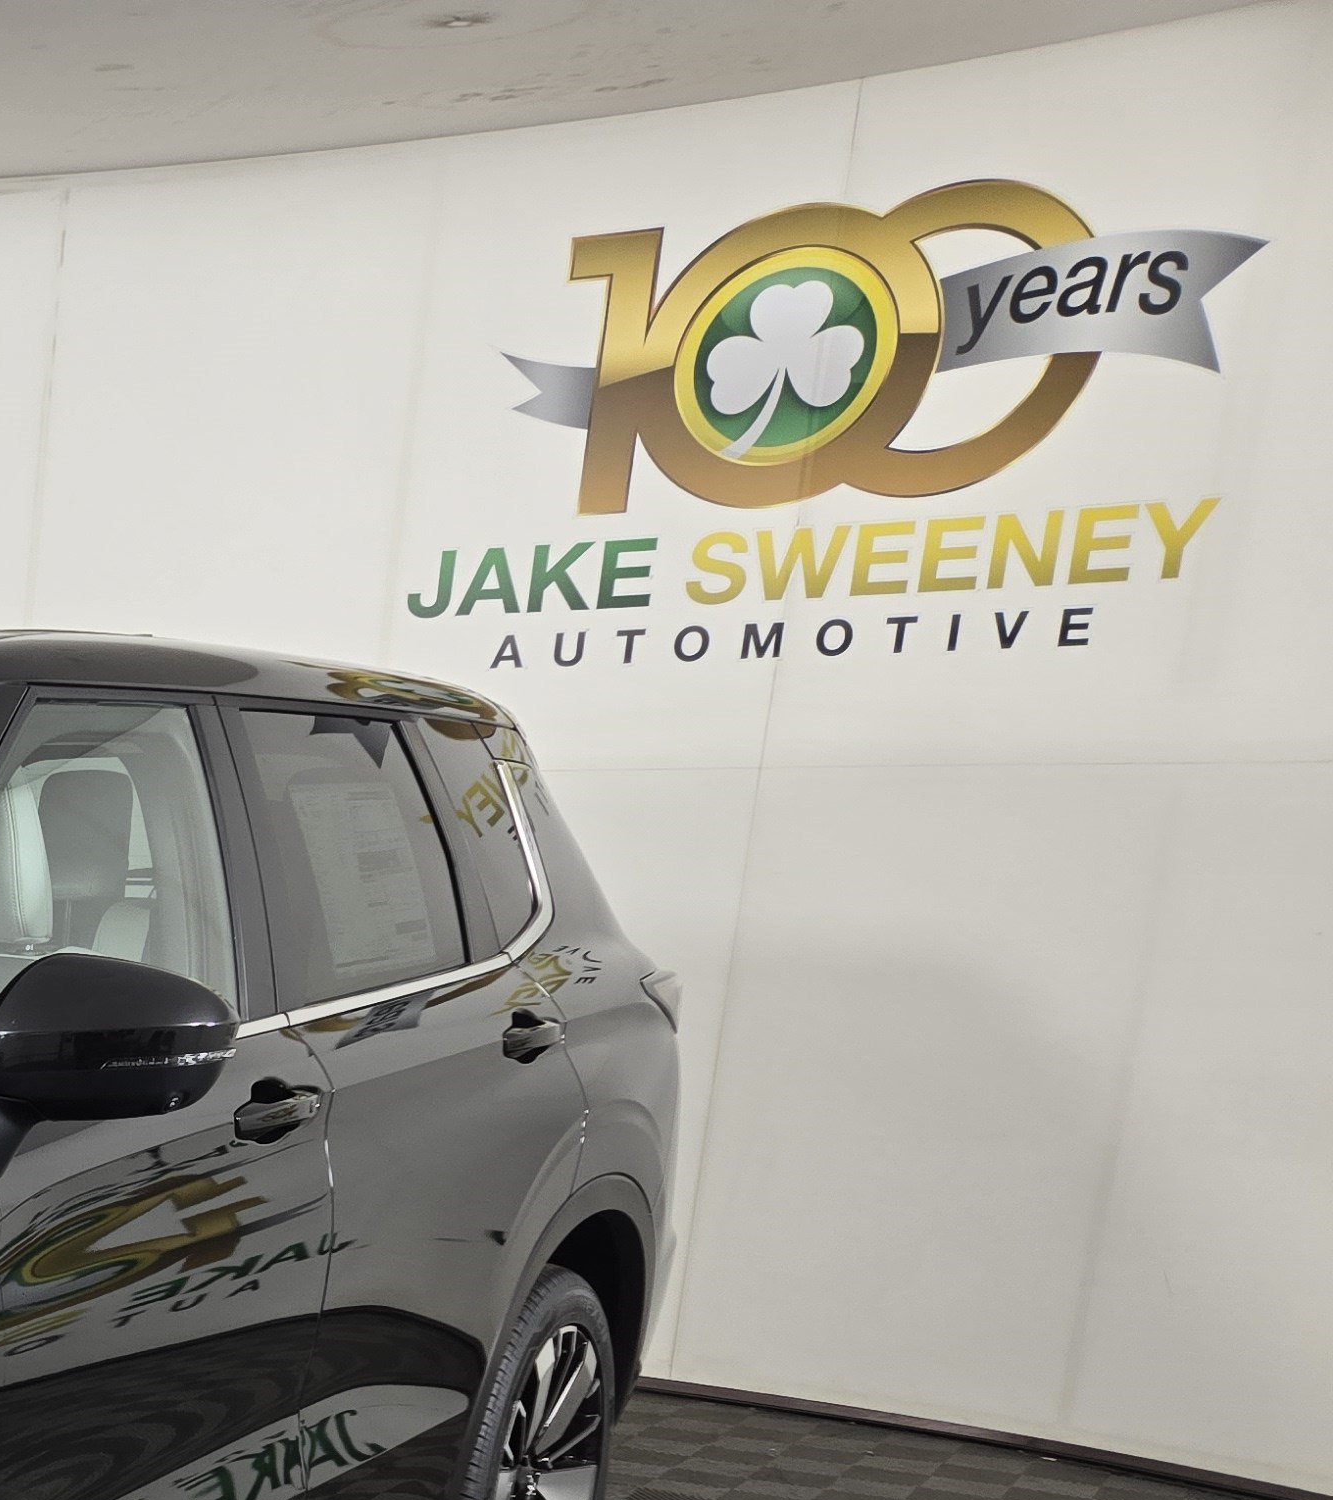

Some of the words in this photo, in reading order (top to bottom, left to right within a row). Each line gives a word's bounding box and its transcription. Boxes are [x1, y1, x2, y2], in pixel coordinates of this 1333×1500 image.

[955, 249, 1190, 357] years
[407, 537, 658, 619] JAKE
[685, 497, 1222, 606] SWEENEY
[489, 607, 1097, 670] AUTOMOTIVE
